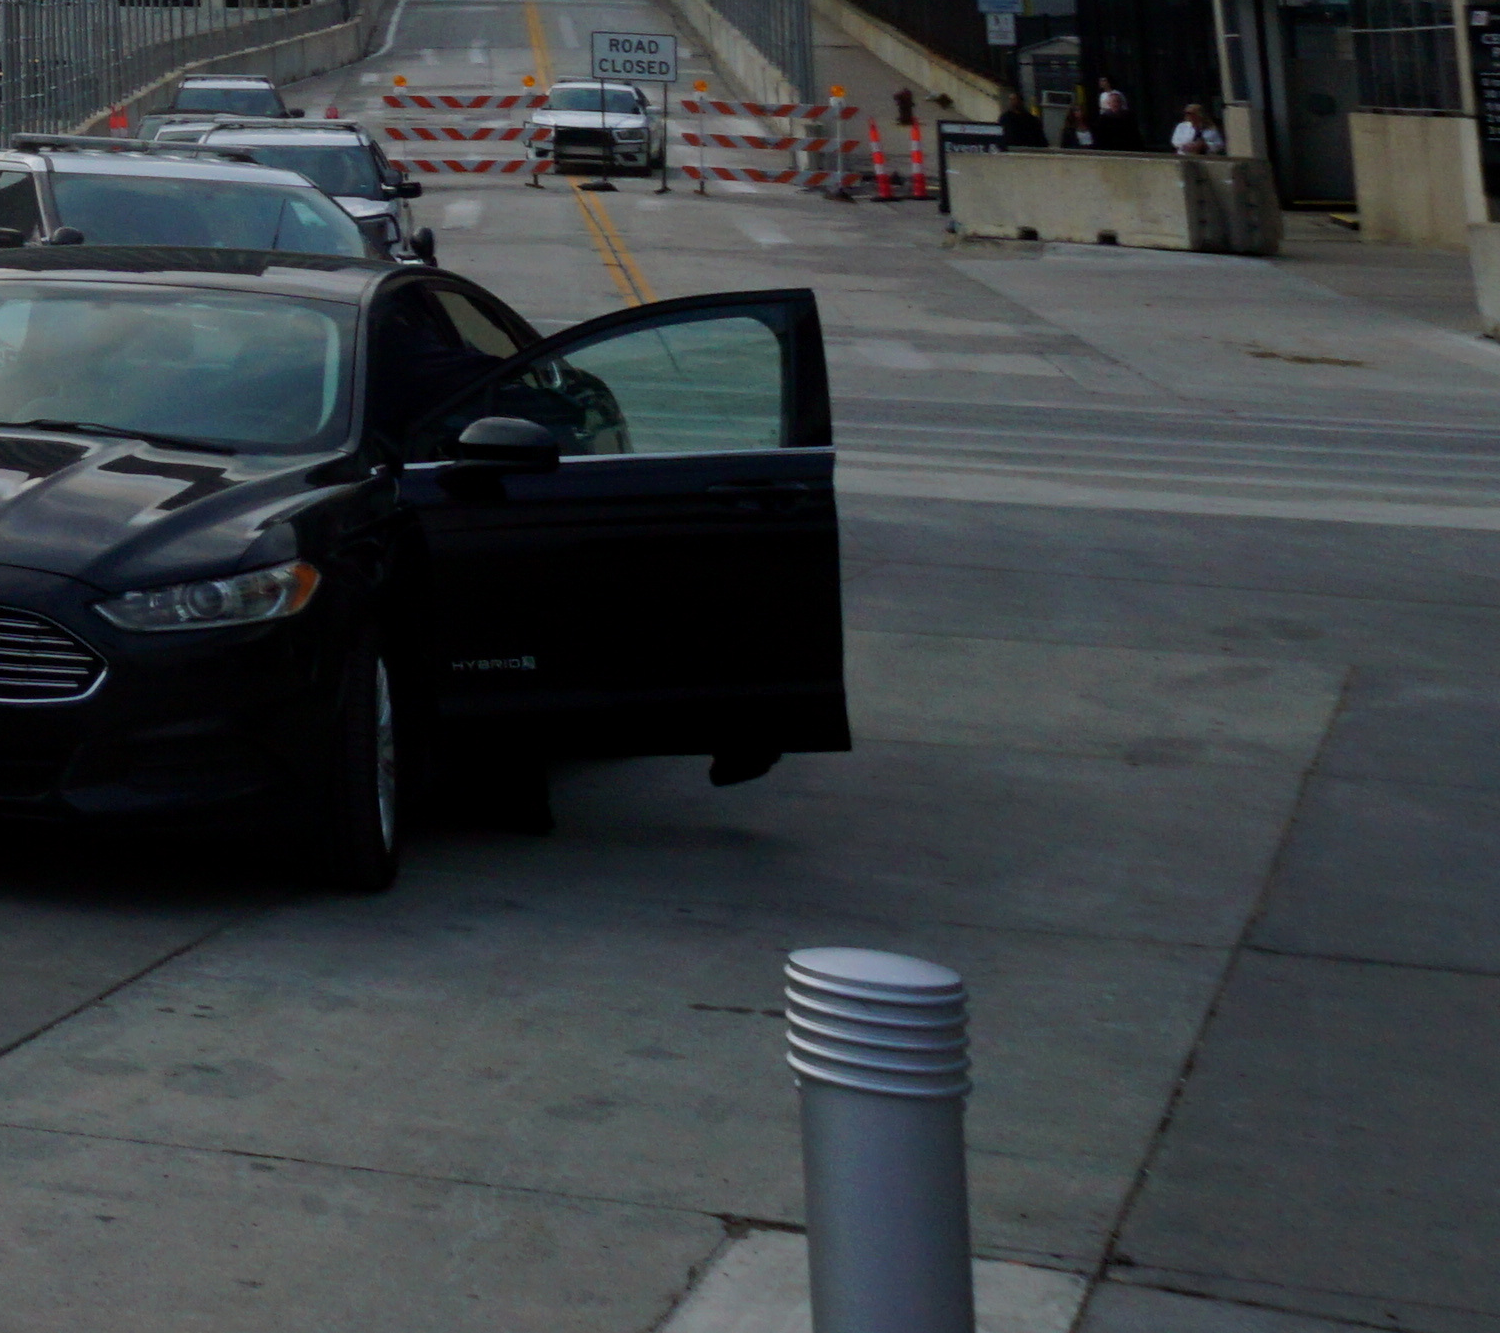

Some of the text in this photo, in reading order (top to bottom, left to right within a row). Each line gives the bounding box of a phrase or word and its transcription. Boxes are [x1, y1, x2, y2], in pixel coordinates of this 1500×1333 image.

[609, 38, 659, 54] ROAD
[599, 58, 670, 75] CLOSED
[944, 141, 984, 153] Event
[451, 658, 520, 671] HYBRID
